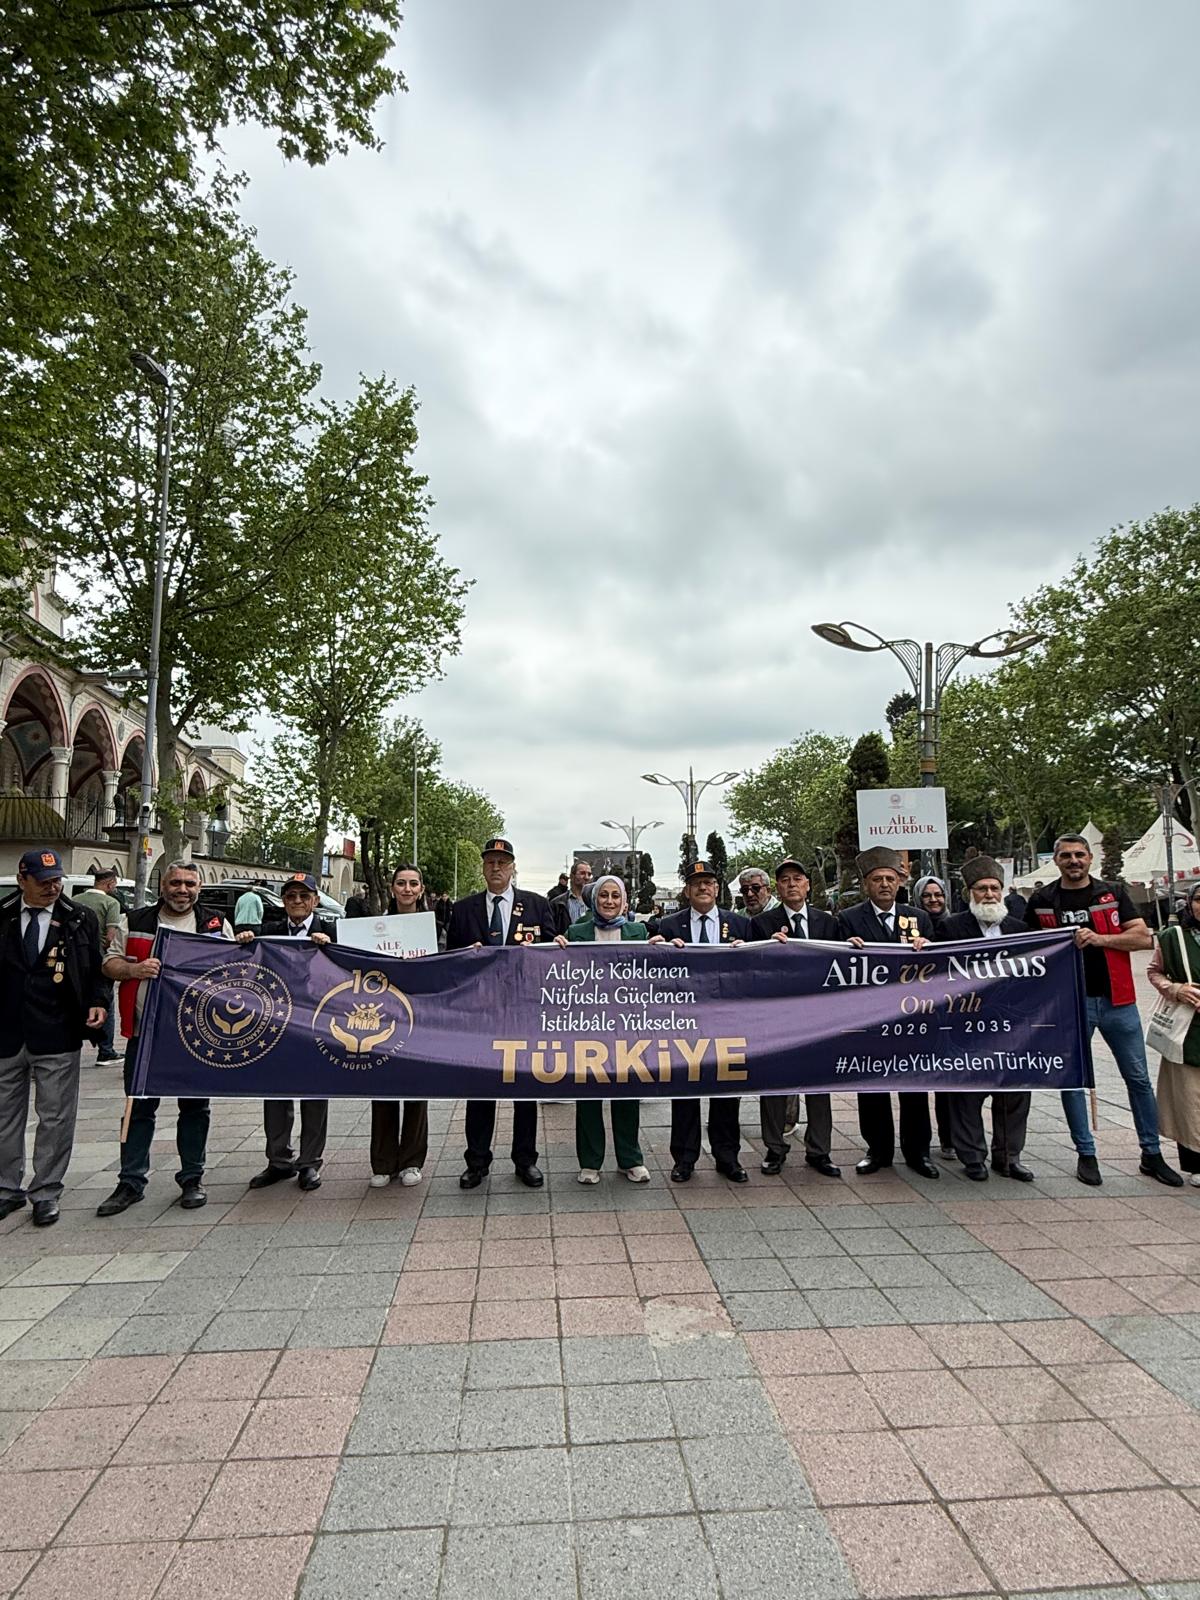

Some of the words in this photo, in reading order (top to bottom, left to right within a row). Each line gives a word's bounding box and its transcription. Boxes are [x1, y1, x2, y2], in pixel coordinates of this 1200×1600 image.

[889, 814, 917, 825] AİLE
[376, 940, 402, 951] AİLE
[545, 960, 604, 986] Aileyle
[608, 958, 690, 980] Köklenen
[822, 955, 889, 987] Aile
[900, 962, 936, 985] ve
[947, 950, 1047, 982] Nüfus
[540, 984, 609, 1011] Nüfusla
[614, 984, 697, 1009] Güçlenen
[900, 995, 936, 1015] On
[943, 991, 982, 1014] Yılı
[541, 1011, 616, 1032] İstikbâle
[619, 1009, 698, 1031] Yükselen
[881, 1023, 928, 1036] 2026
[964, 1020, 1011, 1033] 2035
[314, 1037, 329, 1056] AİLE
[329, 1054, 340, 1065] VE
[342, 1061, 373, 1070] NÜFUS
[376, 1054, 389, 1066] ON
[389, 1040, 405, 1055] YILI
[492, 1037, 748, 1084] TÜRKİYE
[835, 1051, 1064, 1077] #AileyleYükselenTürkiye
